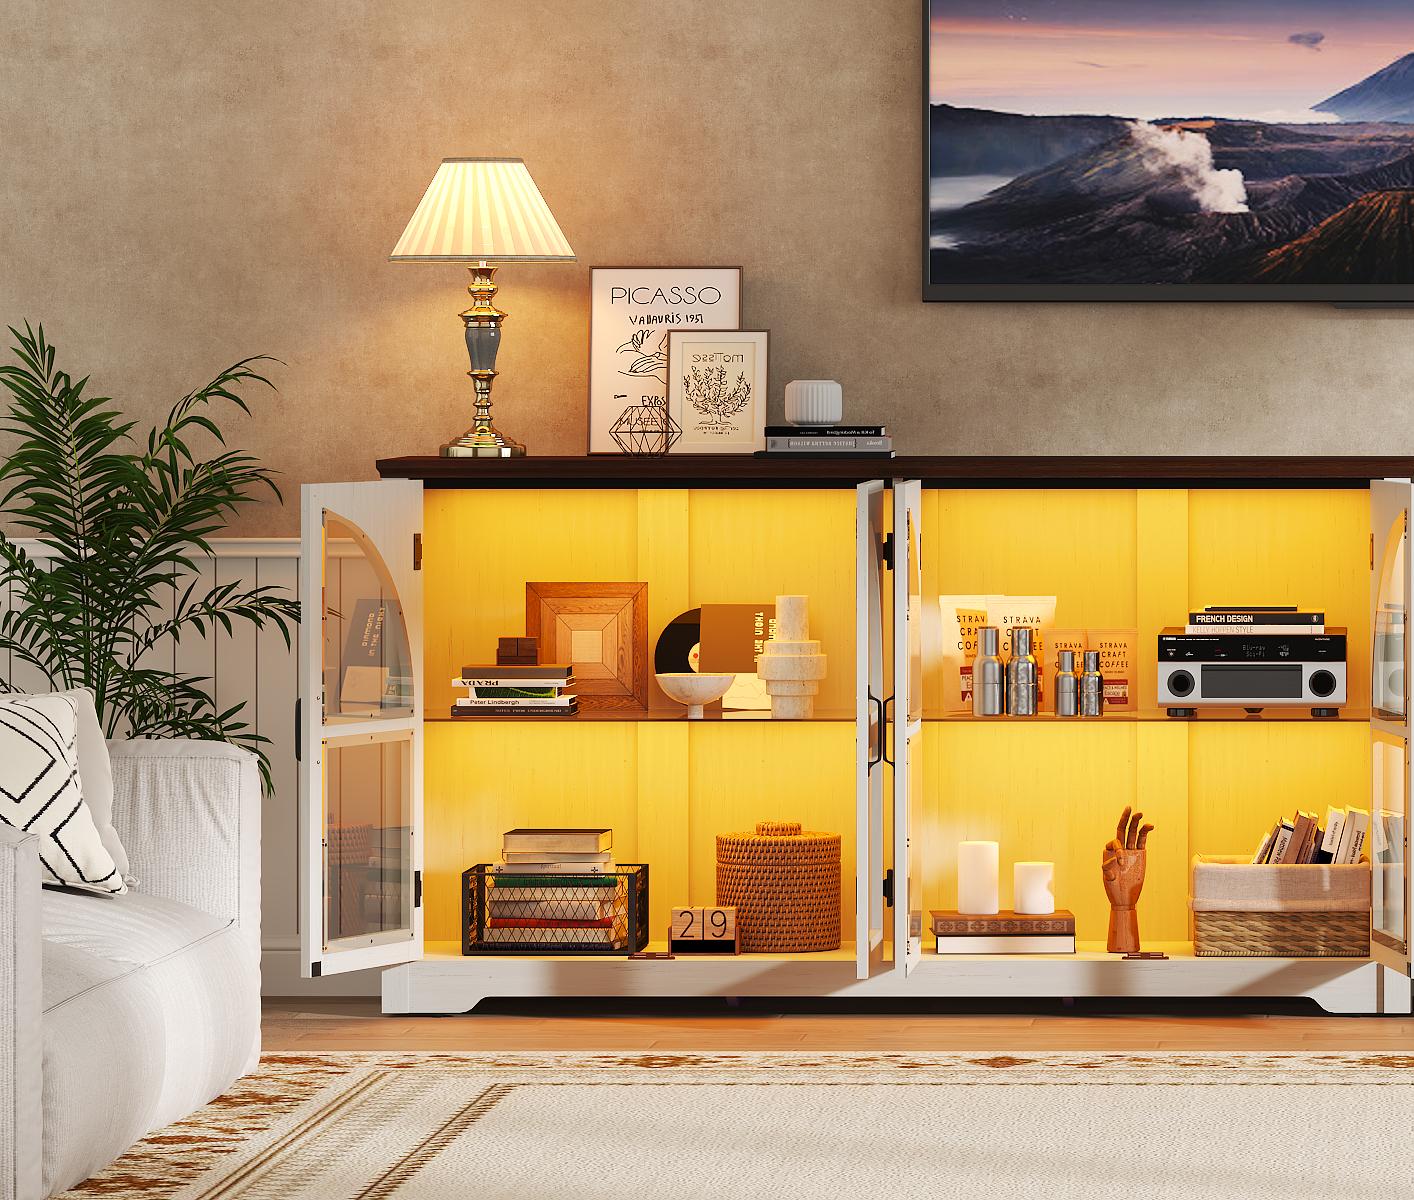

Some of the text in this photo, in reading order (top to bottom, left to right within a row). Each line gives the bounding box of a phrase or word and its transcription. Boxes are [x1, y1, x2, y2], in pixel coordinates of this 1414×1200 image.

[611, 286, 721, 304] PICASSO
[956, 615, 985, 623] STRAV
[1003, 616, 1041, 624] STRAVA
[1196, 614, 1254, 623] FRENCH DESIGN
[1235, 625, 1254, 634] STYLE
